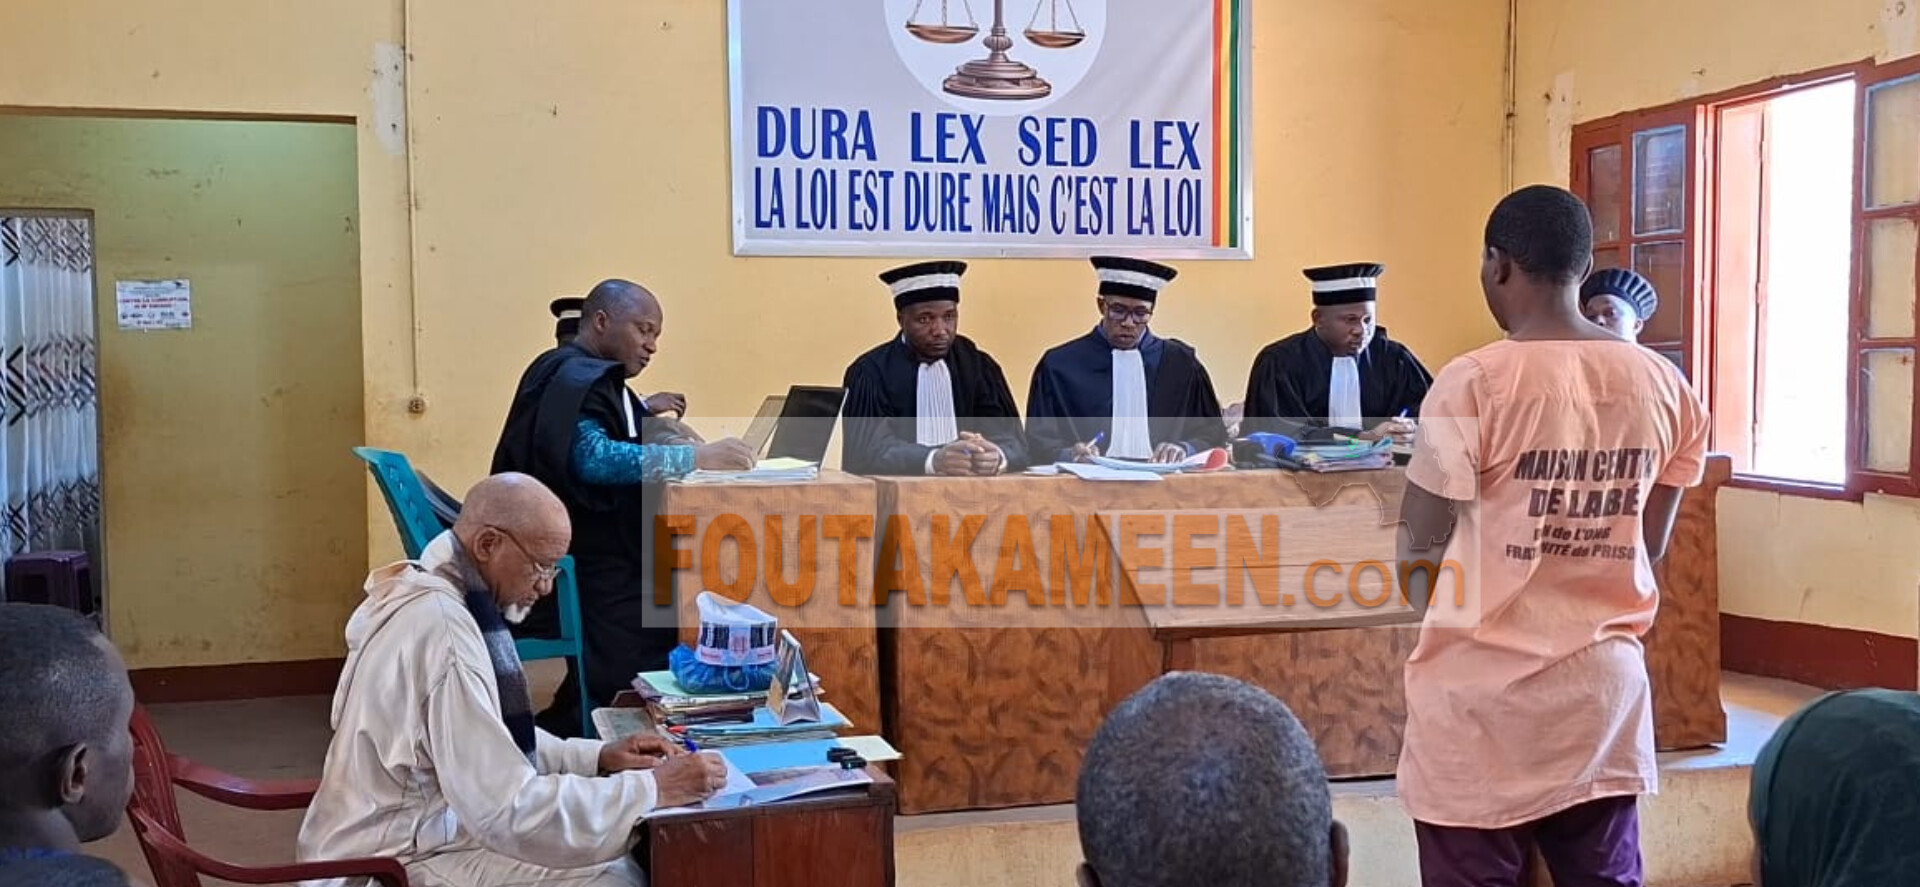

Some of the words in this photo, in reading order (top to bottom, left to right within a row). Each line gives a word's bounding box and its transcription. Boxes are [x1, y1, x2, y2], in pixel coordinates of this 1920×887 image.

[757, 106, 877, 161] DURA
[911, 112, 986, 164] LEX
[1019, 116, 1097, 167] SED
[1131, 120, 1200, 170] LEX
[755, 167, 785, 228] LA
[796, 168, 836, 229] LOI
[849, 170, 894, 231] EST
[905, 171, 972, 232] DURE
[983, 174, 1040, 234] MAIS
[1128, 178, 1154, 235] LA
[1164, 178, 1201, 236] LOI
[1514, 449, 1588, 481] MAISON
[1528, 487, 1564, 517] DE
[1567, 482, 1640, 518] LABÉ
[1552, 526, 1572, 541] de
[1591, 544, 1635, 560] PRISO
